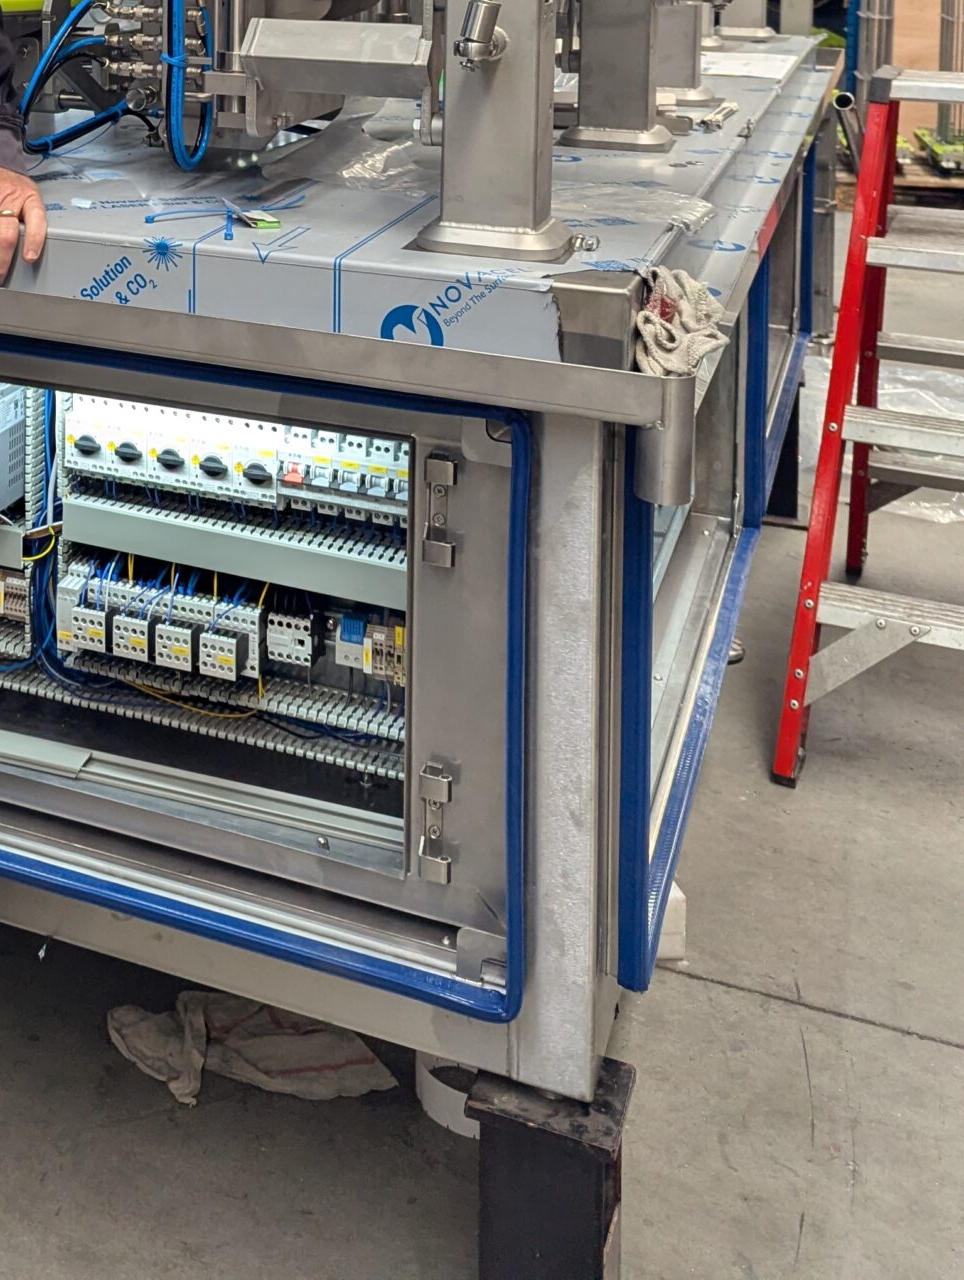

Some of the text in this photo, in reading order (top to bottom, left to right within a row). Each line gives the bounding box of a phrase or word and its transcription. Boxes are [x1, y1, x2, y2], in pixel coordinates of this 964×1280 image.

[80, 255, 133, 301] Solution
[443, 302, 473, 328] Beyond
[469, 291, 487, 306] The
